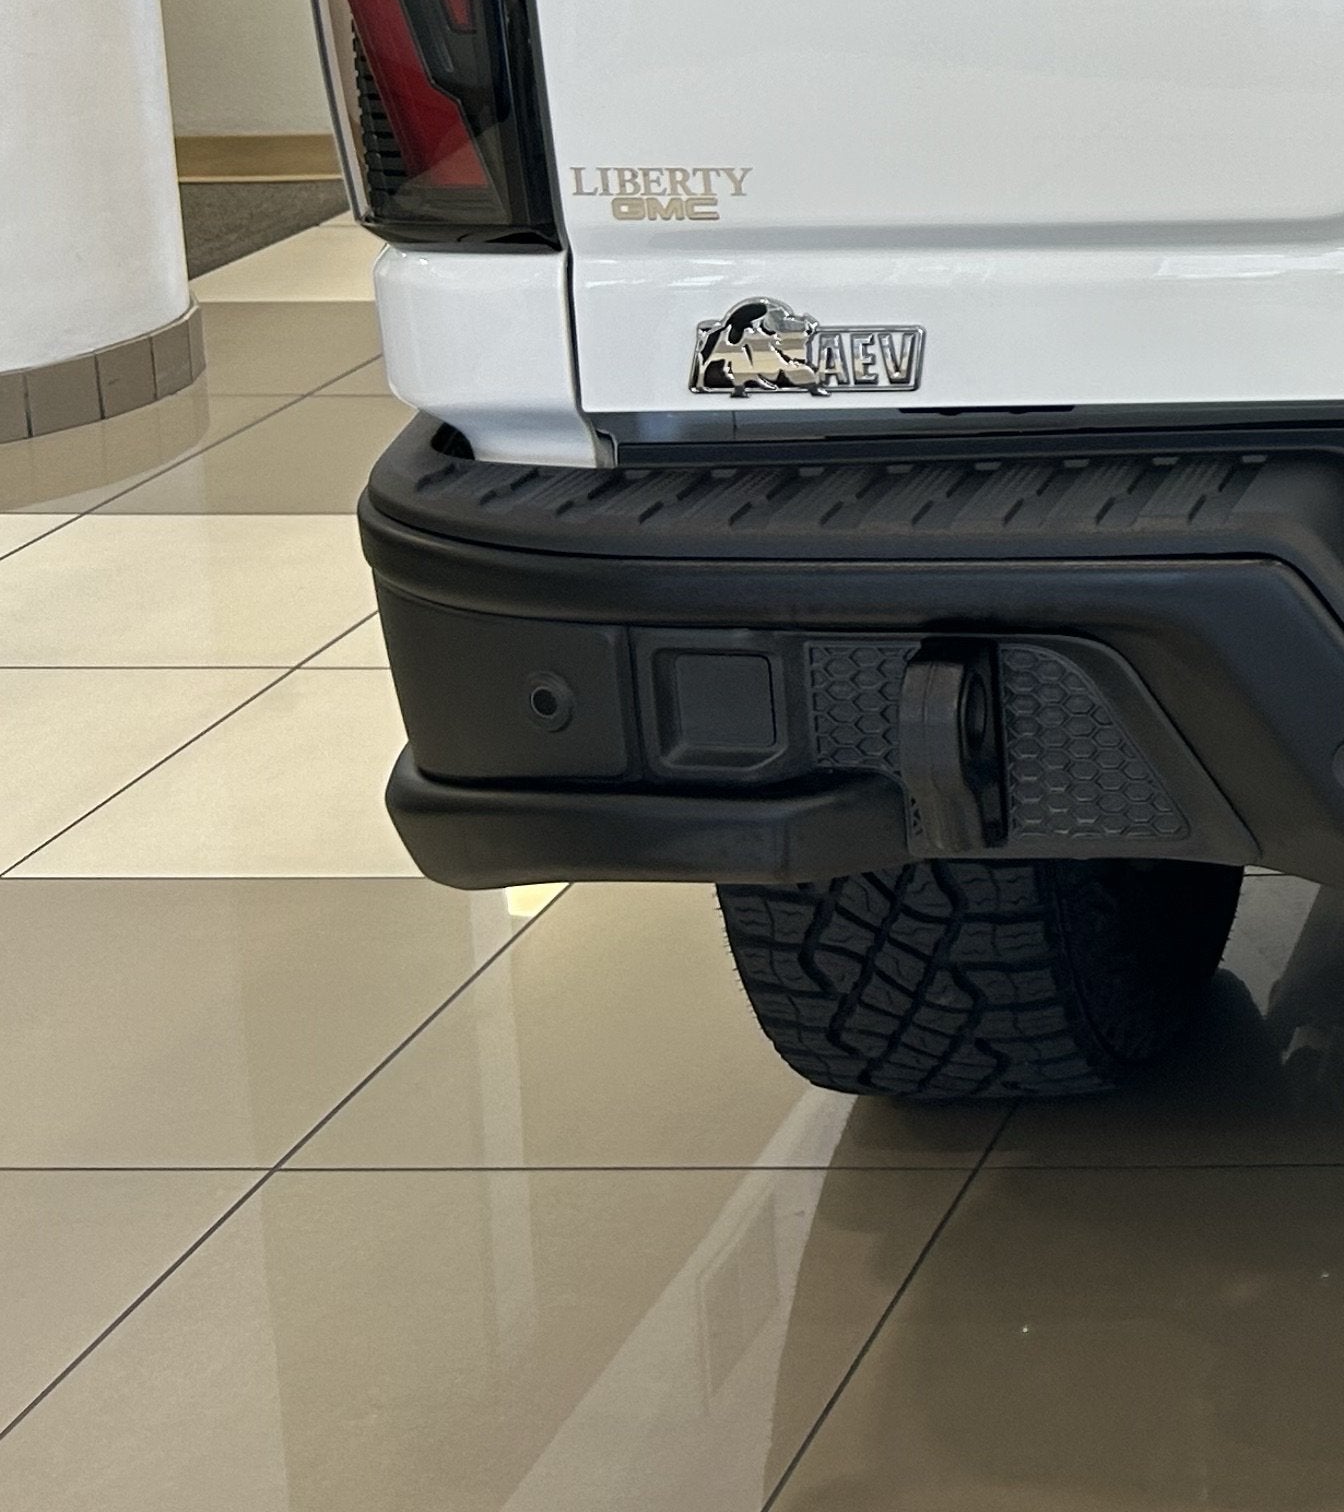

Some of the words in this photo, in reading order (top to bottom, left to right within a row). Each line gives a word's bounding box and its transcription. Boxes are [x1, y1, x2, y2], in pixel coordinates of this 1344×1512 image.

[570, 166, 753, 197] LIBERTY
[611, 196, 720, 221] GMC
[818, 332, 915, 388] AEV
